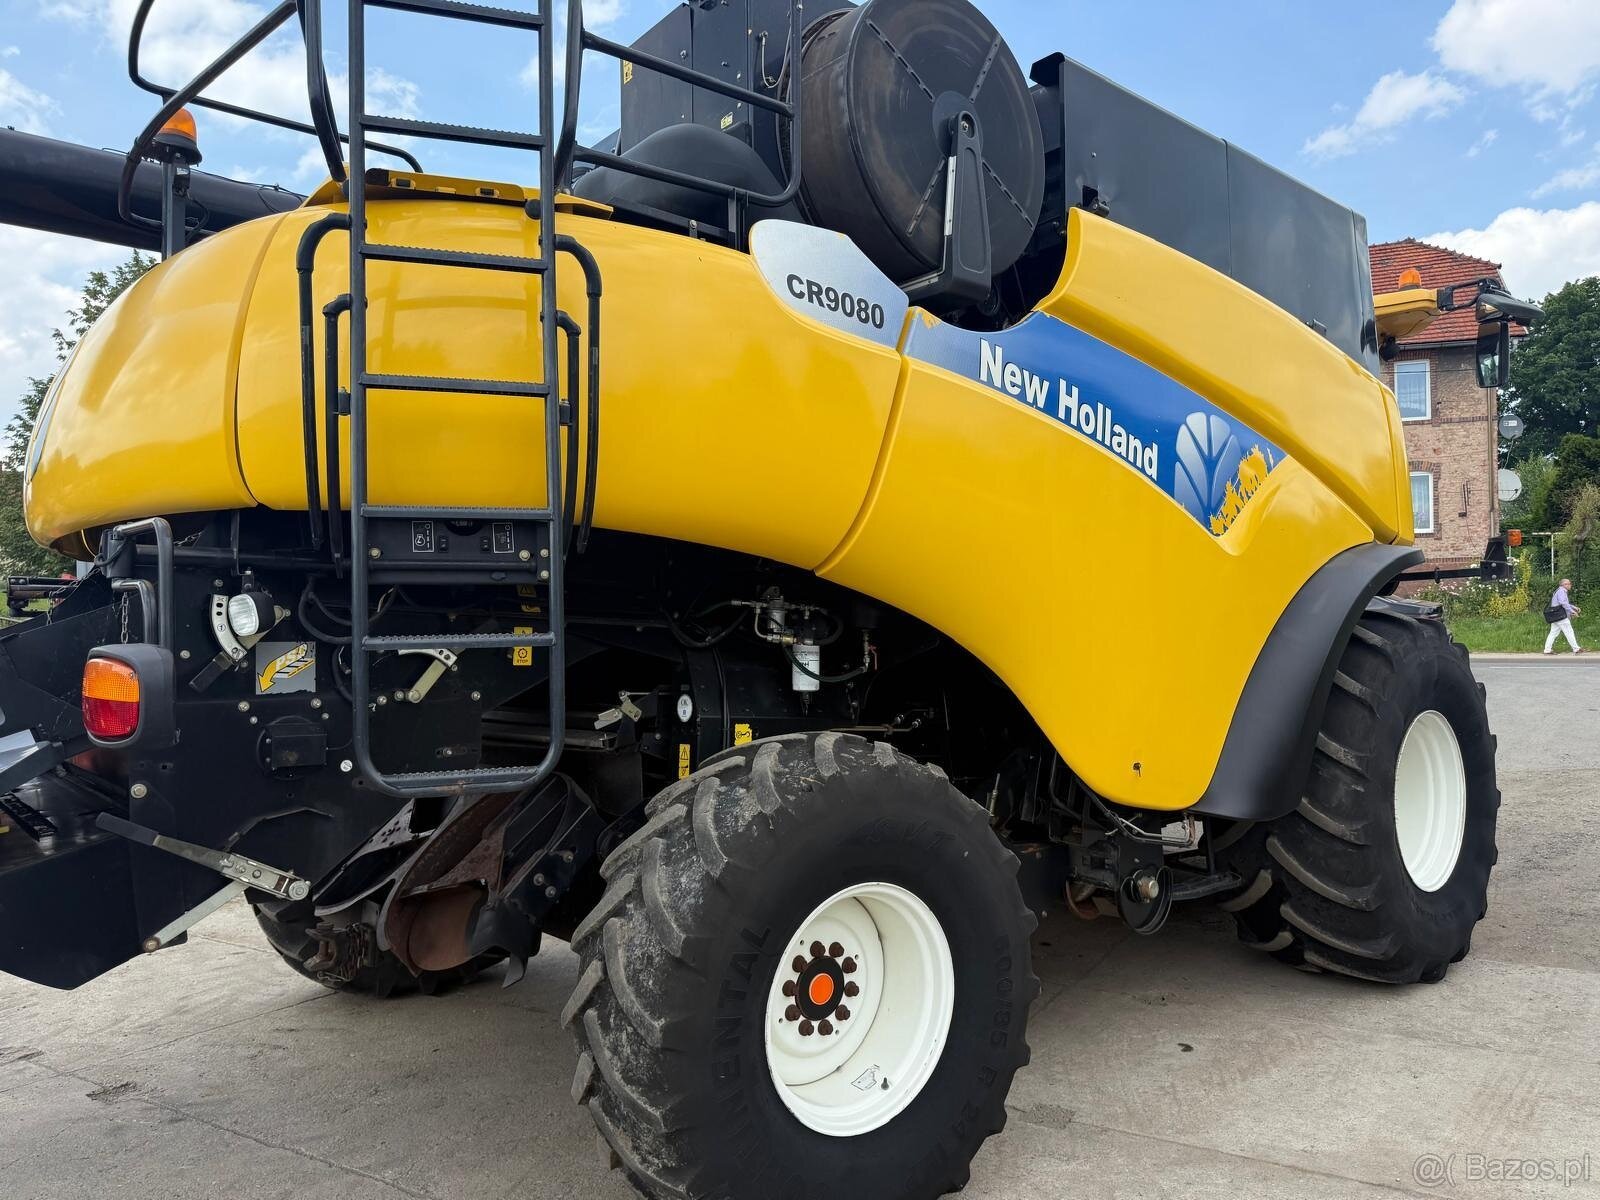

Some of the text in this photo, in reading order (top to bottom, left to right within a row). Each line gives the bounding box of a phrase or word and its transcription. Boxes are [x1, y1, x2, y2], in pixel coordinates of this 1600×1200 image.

[786, 273, 884, 329] CR9080
[979, 337, 1158, 481] New Holland
